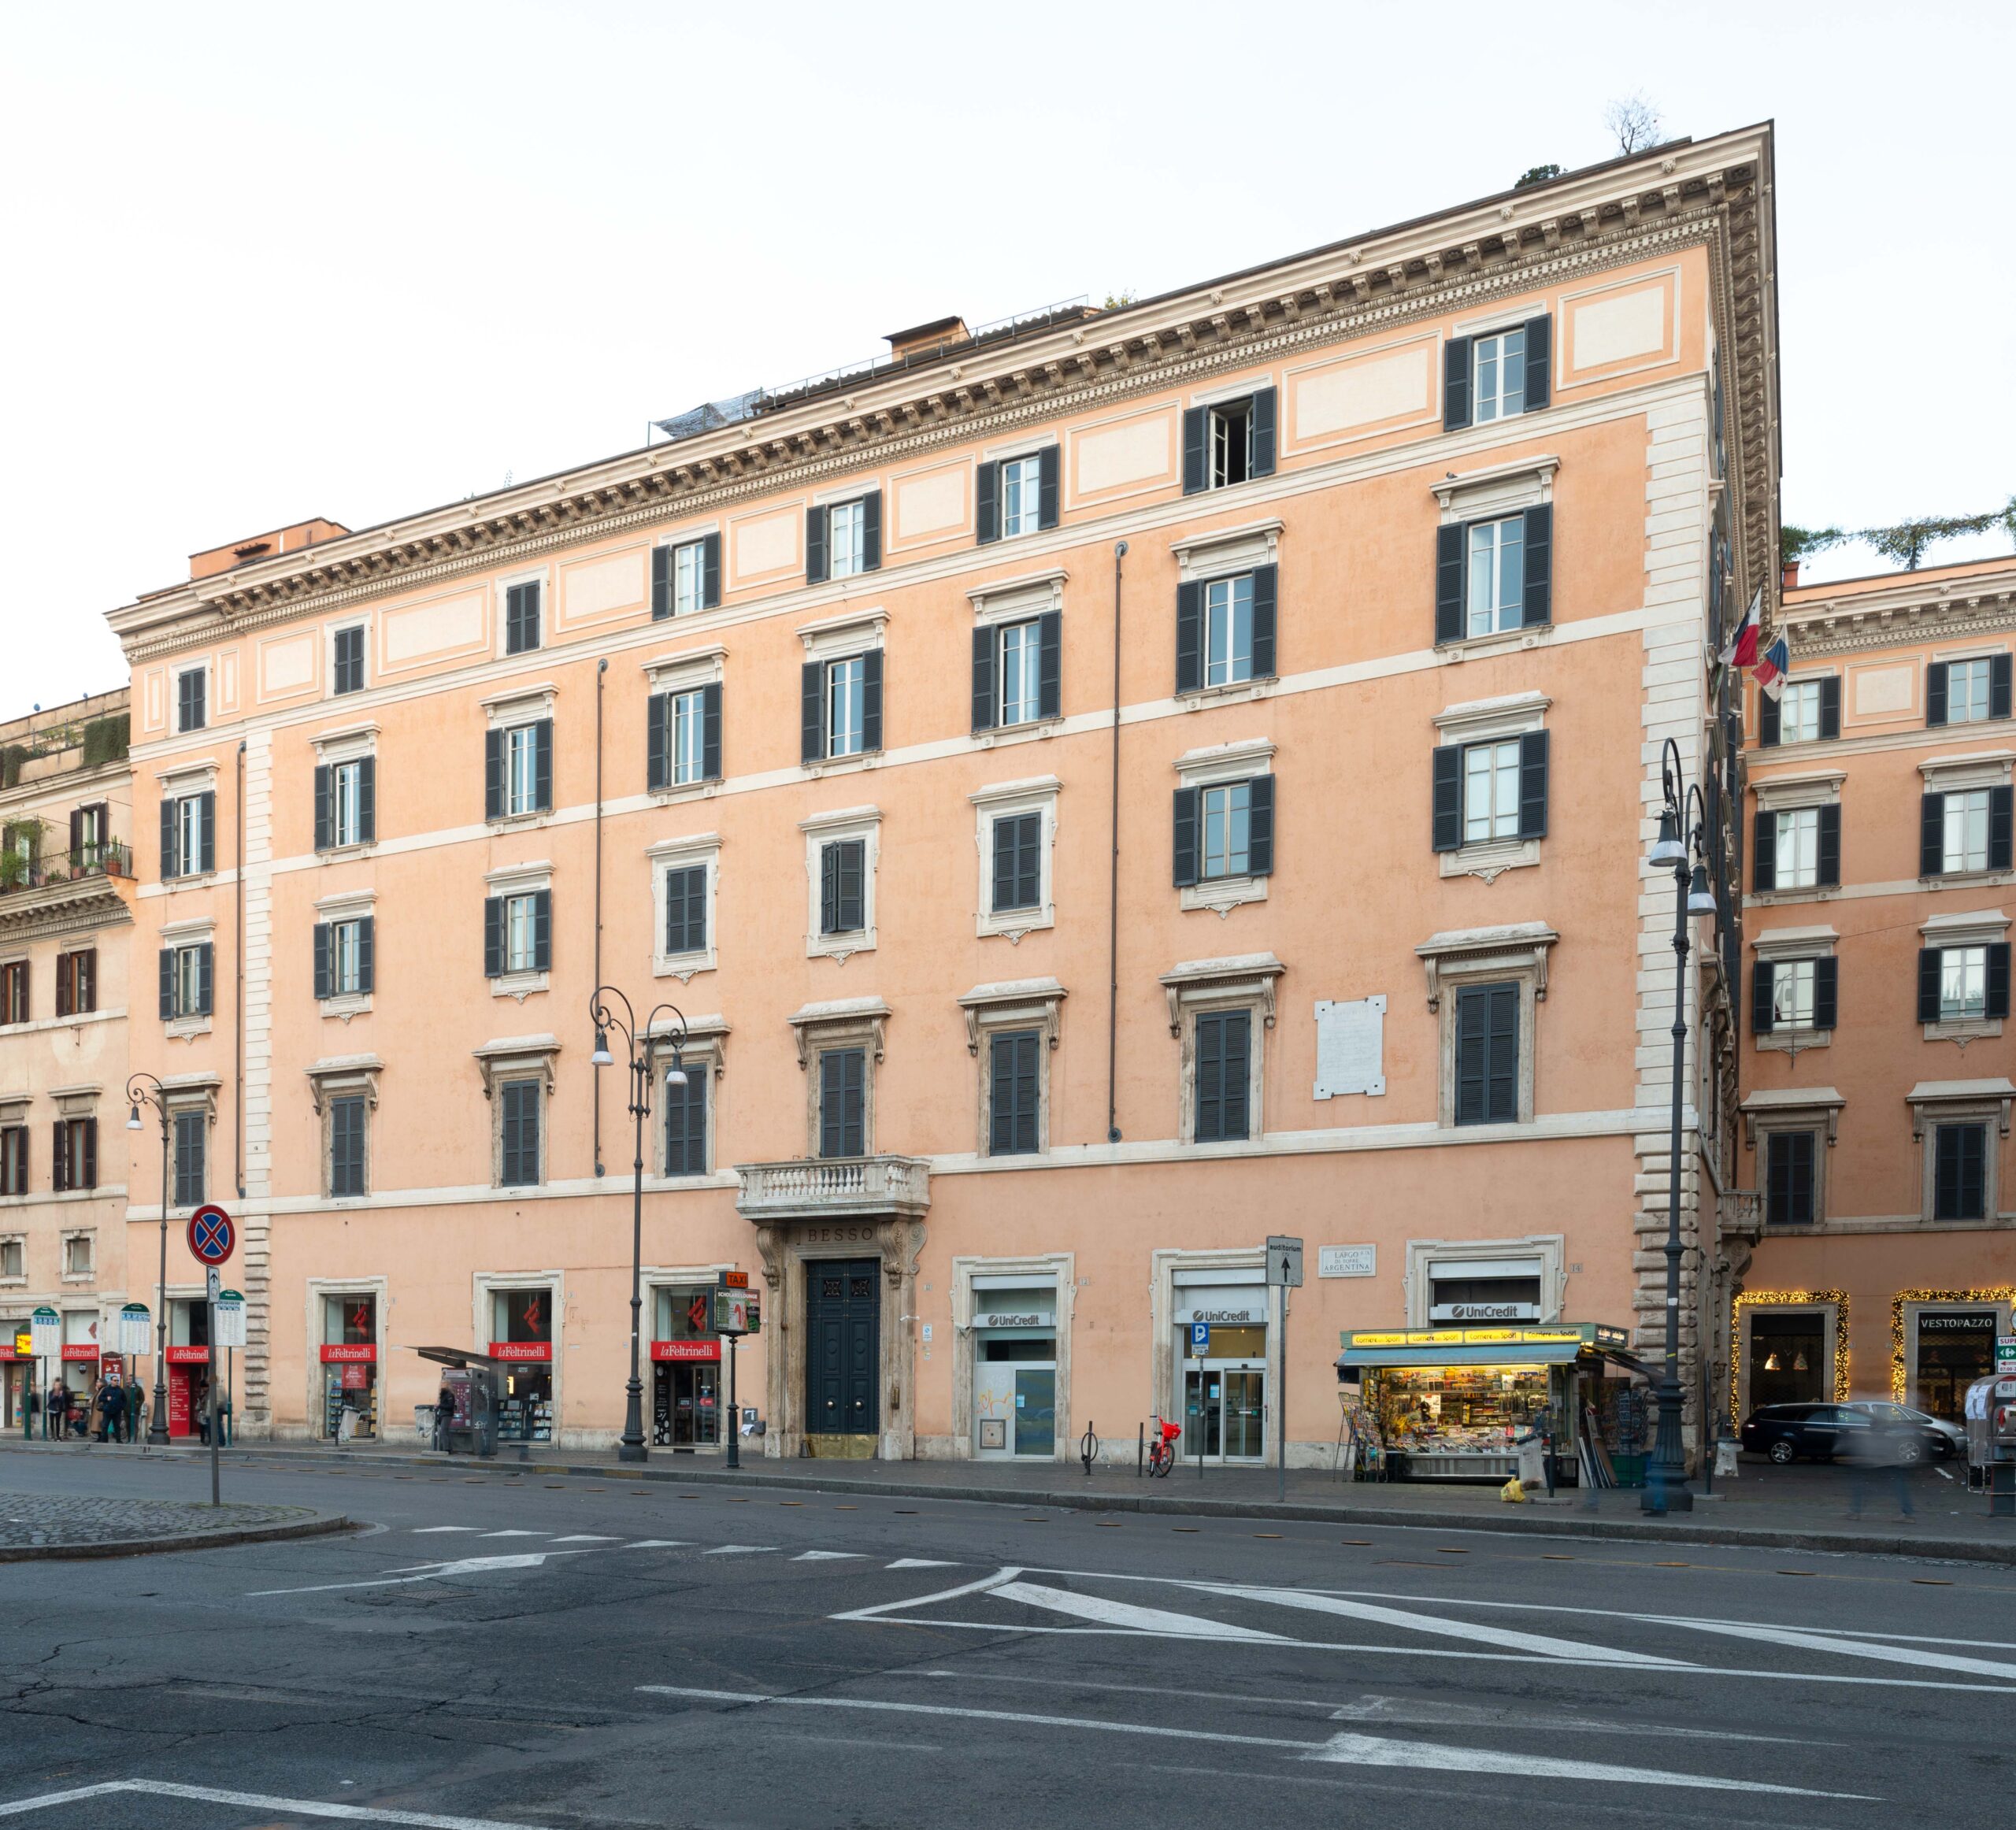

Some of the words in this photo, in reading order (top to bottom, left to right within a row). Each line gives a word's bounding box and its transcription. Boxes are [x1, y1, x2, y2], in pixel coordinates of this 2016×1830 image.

[808, 1228, 873, 1242] BESSO
[1269, 1244, 1302, 1253] auditorium
[1324, 1263, 1370, 1272] ARGENTINA
[728, 1274, 747, 1284] TAXI
[1205, 1310, 1250, 1321] UniCredit
[1466, 1306, 1518, 1317] UniCredit
[999, 1315, 1040, 1326] UniCredit
[1922, 1318, 1992, 1328] VESTOPAZZO
[64, 1347, 98, 1357] laFeltrinelli
[172, 1350, 209, 1359] laFeltrinell
[328, 1347, 371, 1358] laFeltrinelli
[498, 1346, 545, 1357] laFeltrinelli
[660, 1345, 713, 1357] laFeltrinelli
